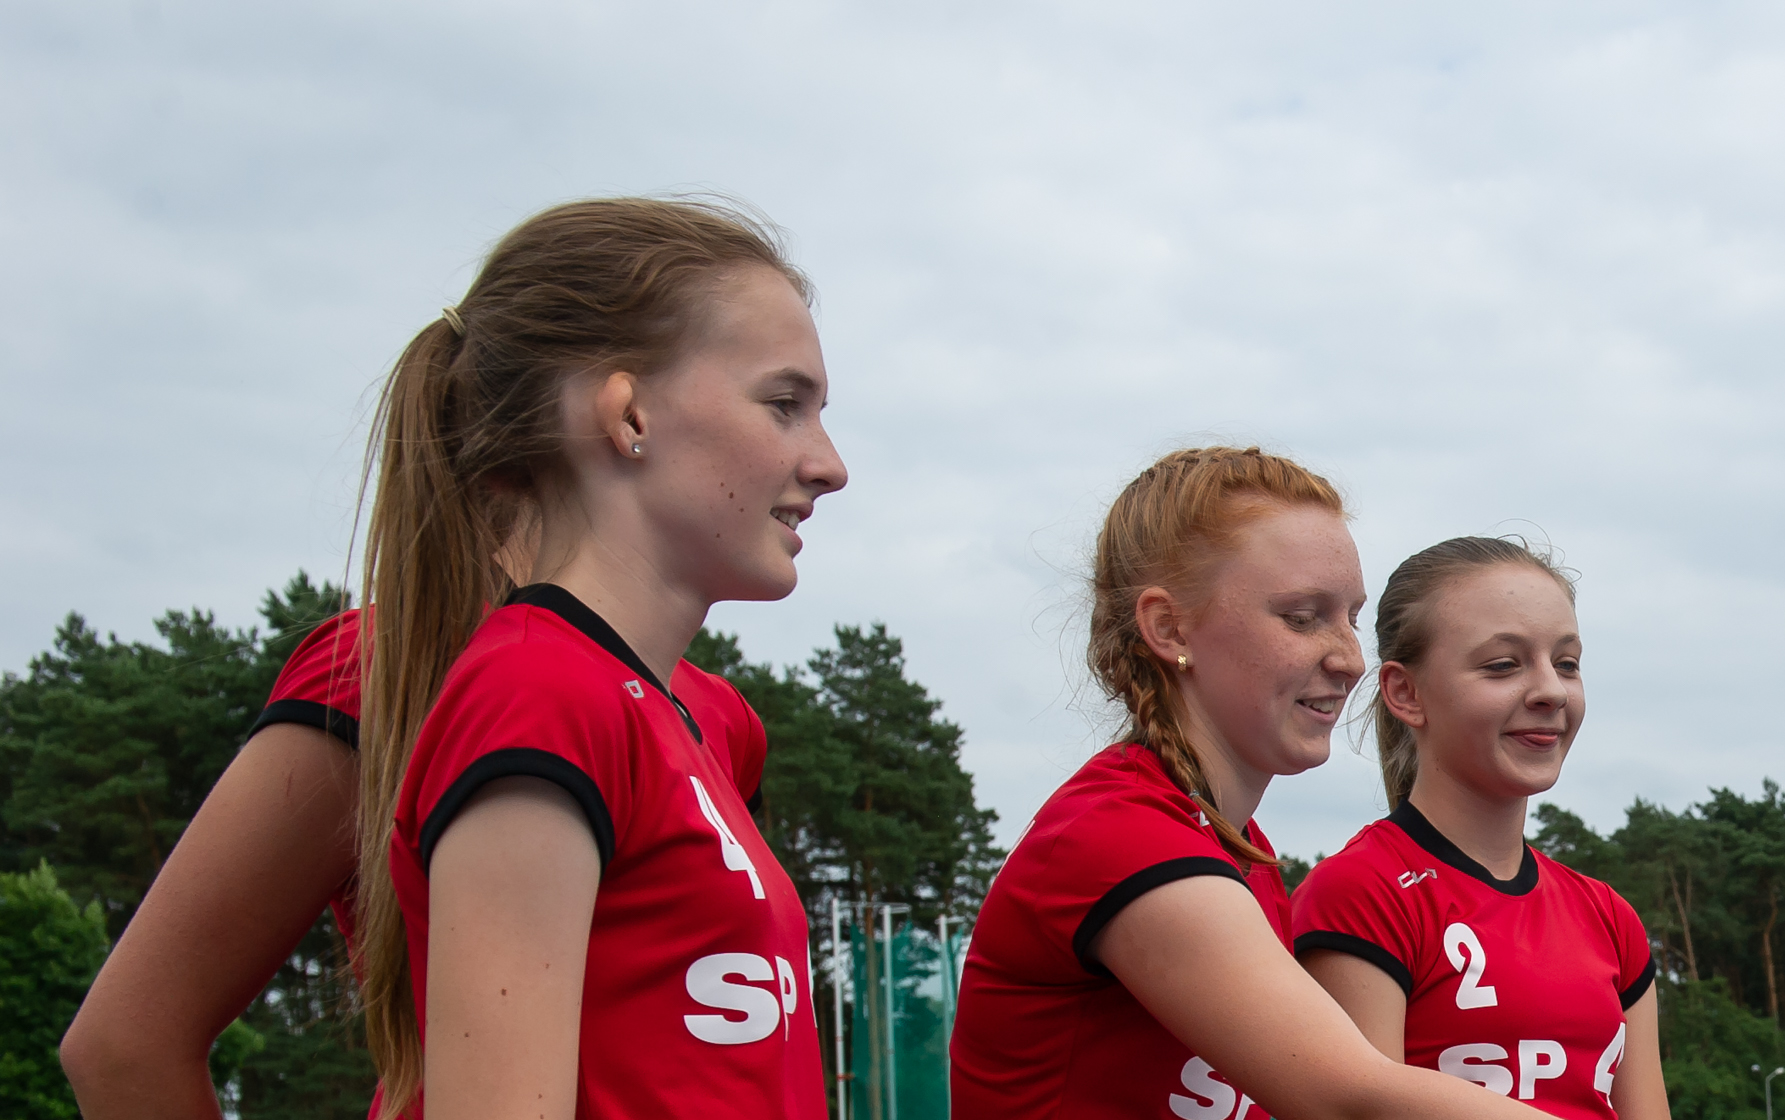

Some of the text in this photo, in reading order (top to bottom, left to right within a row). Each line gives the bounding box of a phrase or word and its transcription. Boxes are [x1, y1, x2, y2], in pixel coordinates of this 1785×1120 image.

[689, 775, 767, 900] 4
[683, 952, 798, 1045] SP
[1443, 921, 1499, 1011] 2
[1437, 1039, 1568, 1101] SP
